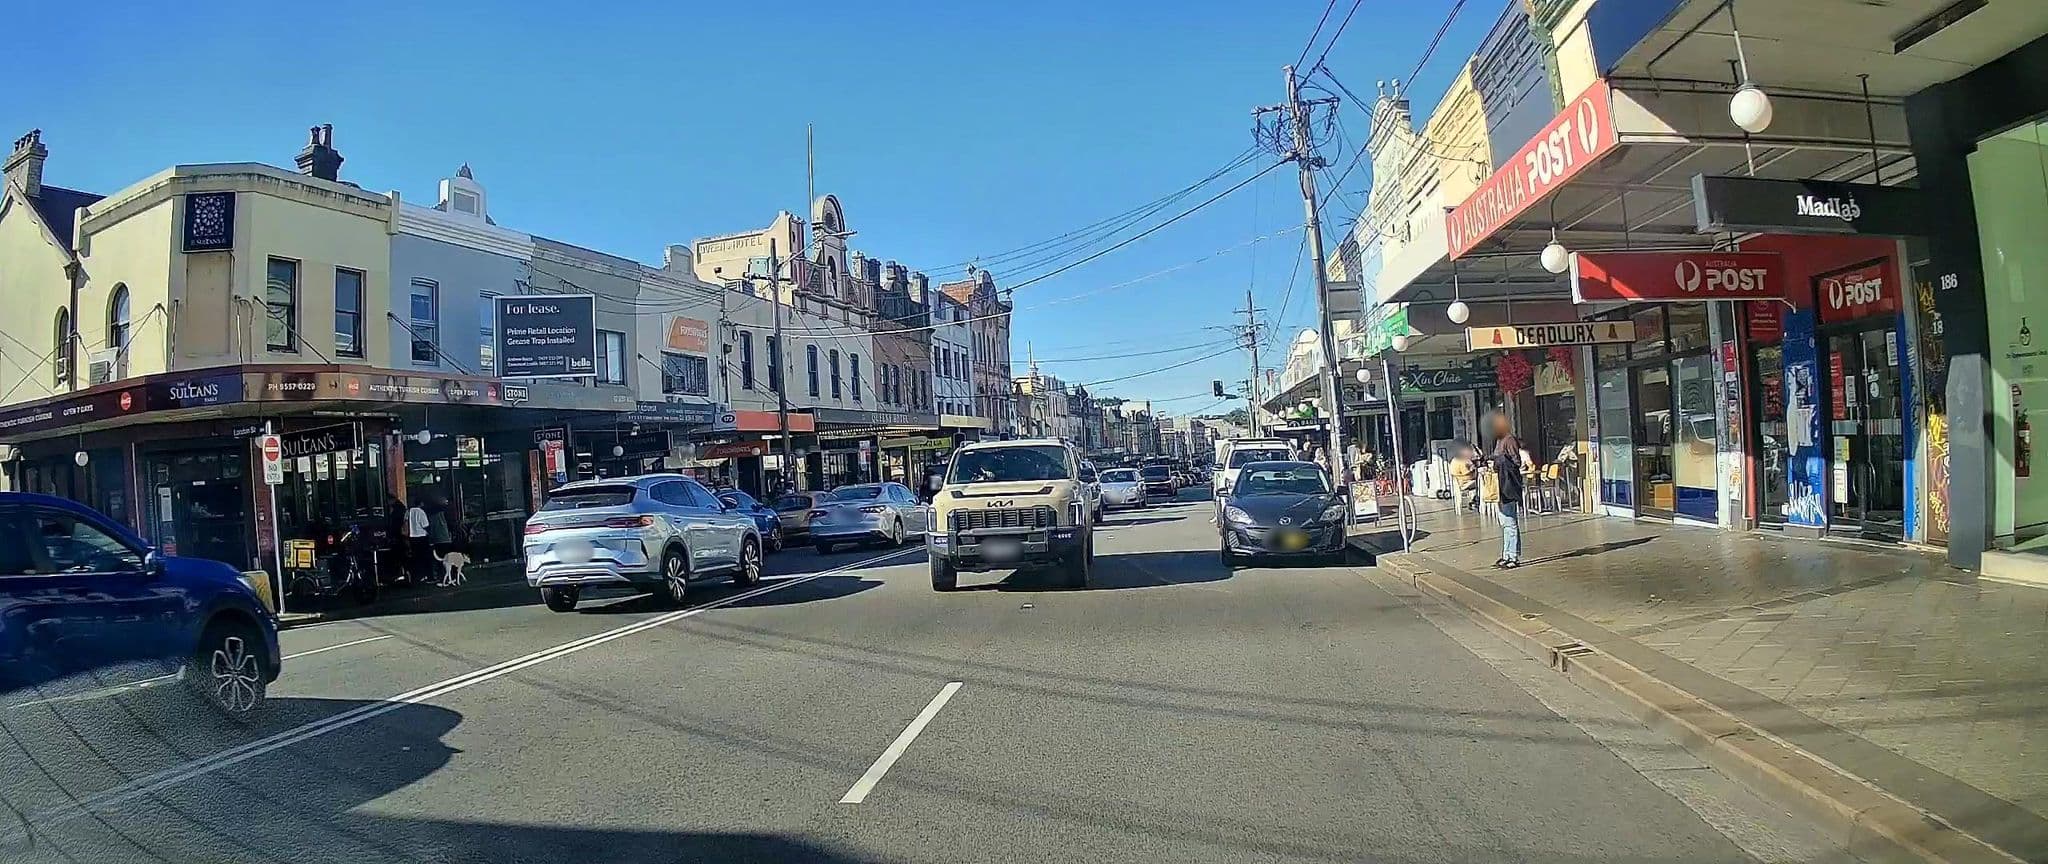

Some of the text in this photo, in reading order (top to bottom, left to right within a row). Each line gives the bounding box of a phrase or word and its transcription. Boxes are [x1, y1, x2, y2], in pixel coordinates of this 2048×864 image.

[1463, 119, 1574, 242] AUSTRALIA POST
[1705, 268, 1767, 291] POST
[1940, 273, 1958, 290] 186
[1845, 277, 1882, 307] POST
[506, 303, 560, 314] For lease.
[528, 327, 547, 335] Retail
[547, 326, 576, 334] Location
[1515, 323, 1596, 344] DEADWAX
[531, 337, 546, 346] Trap
[547, 336, 575, 344] Installed
[571, 358, 591, 367] bella
[169, 383, 219, 400] SULTAN'S
[268, 383, 278, 391] PH
[506, 388, 527, 399] STONE
[536, 432, 562, 441] STONE
[281, 432, 336, 457] SULTAN'S
[987, 500, 1014, 508] KIA
